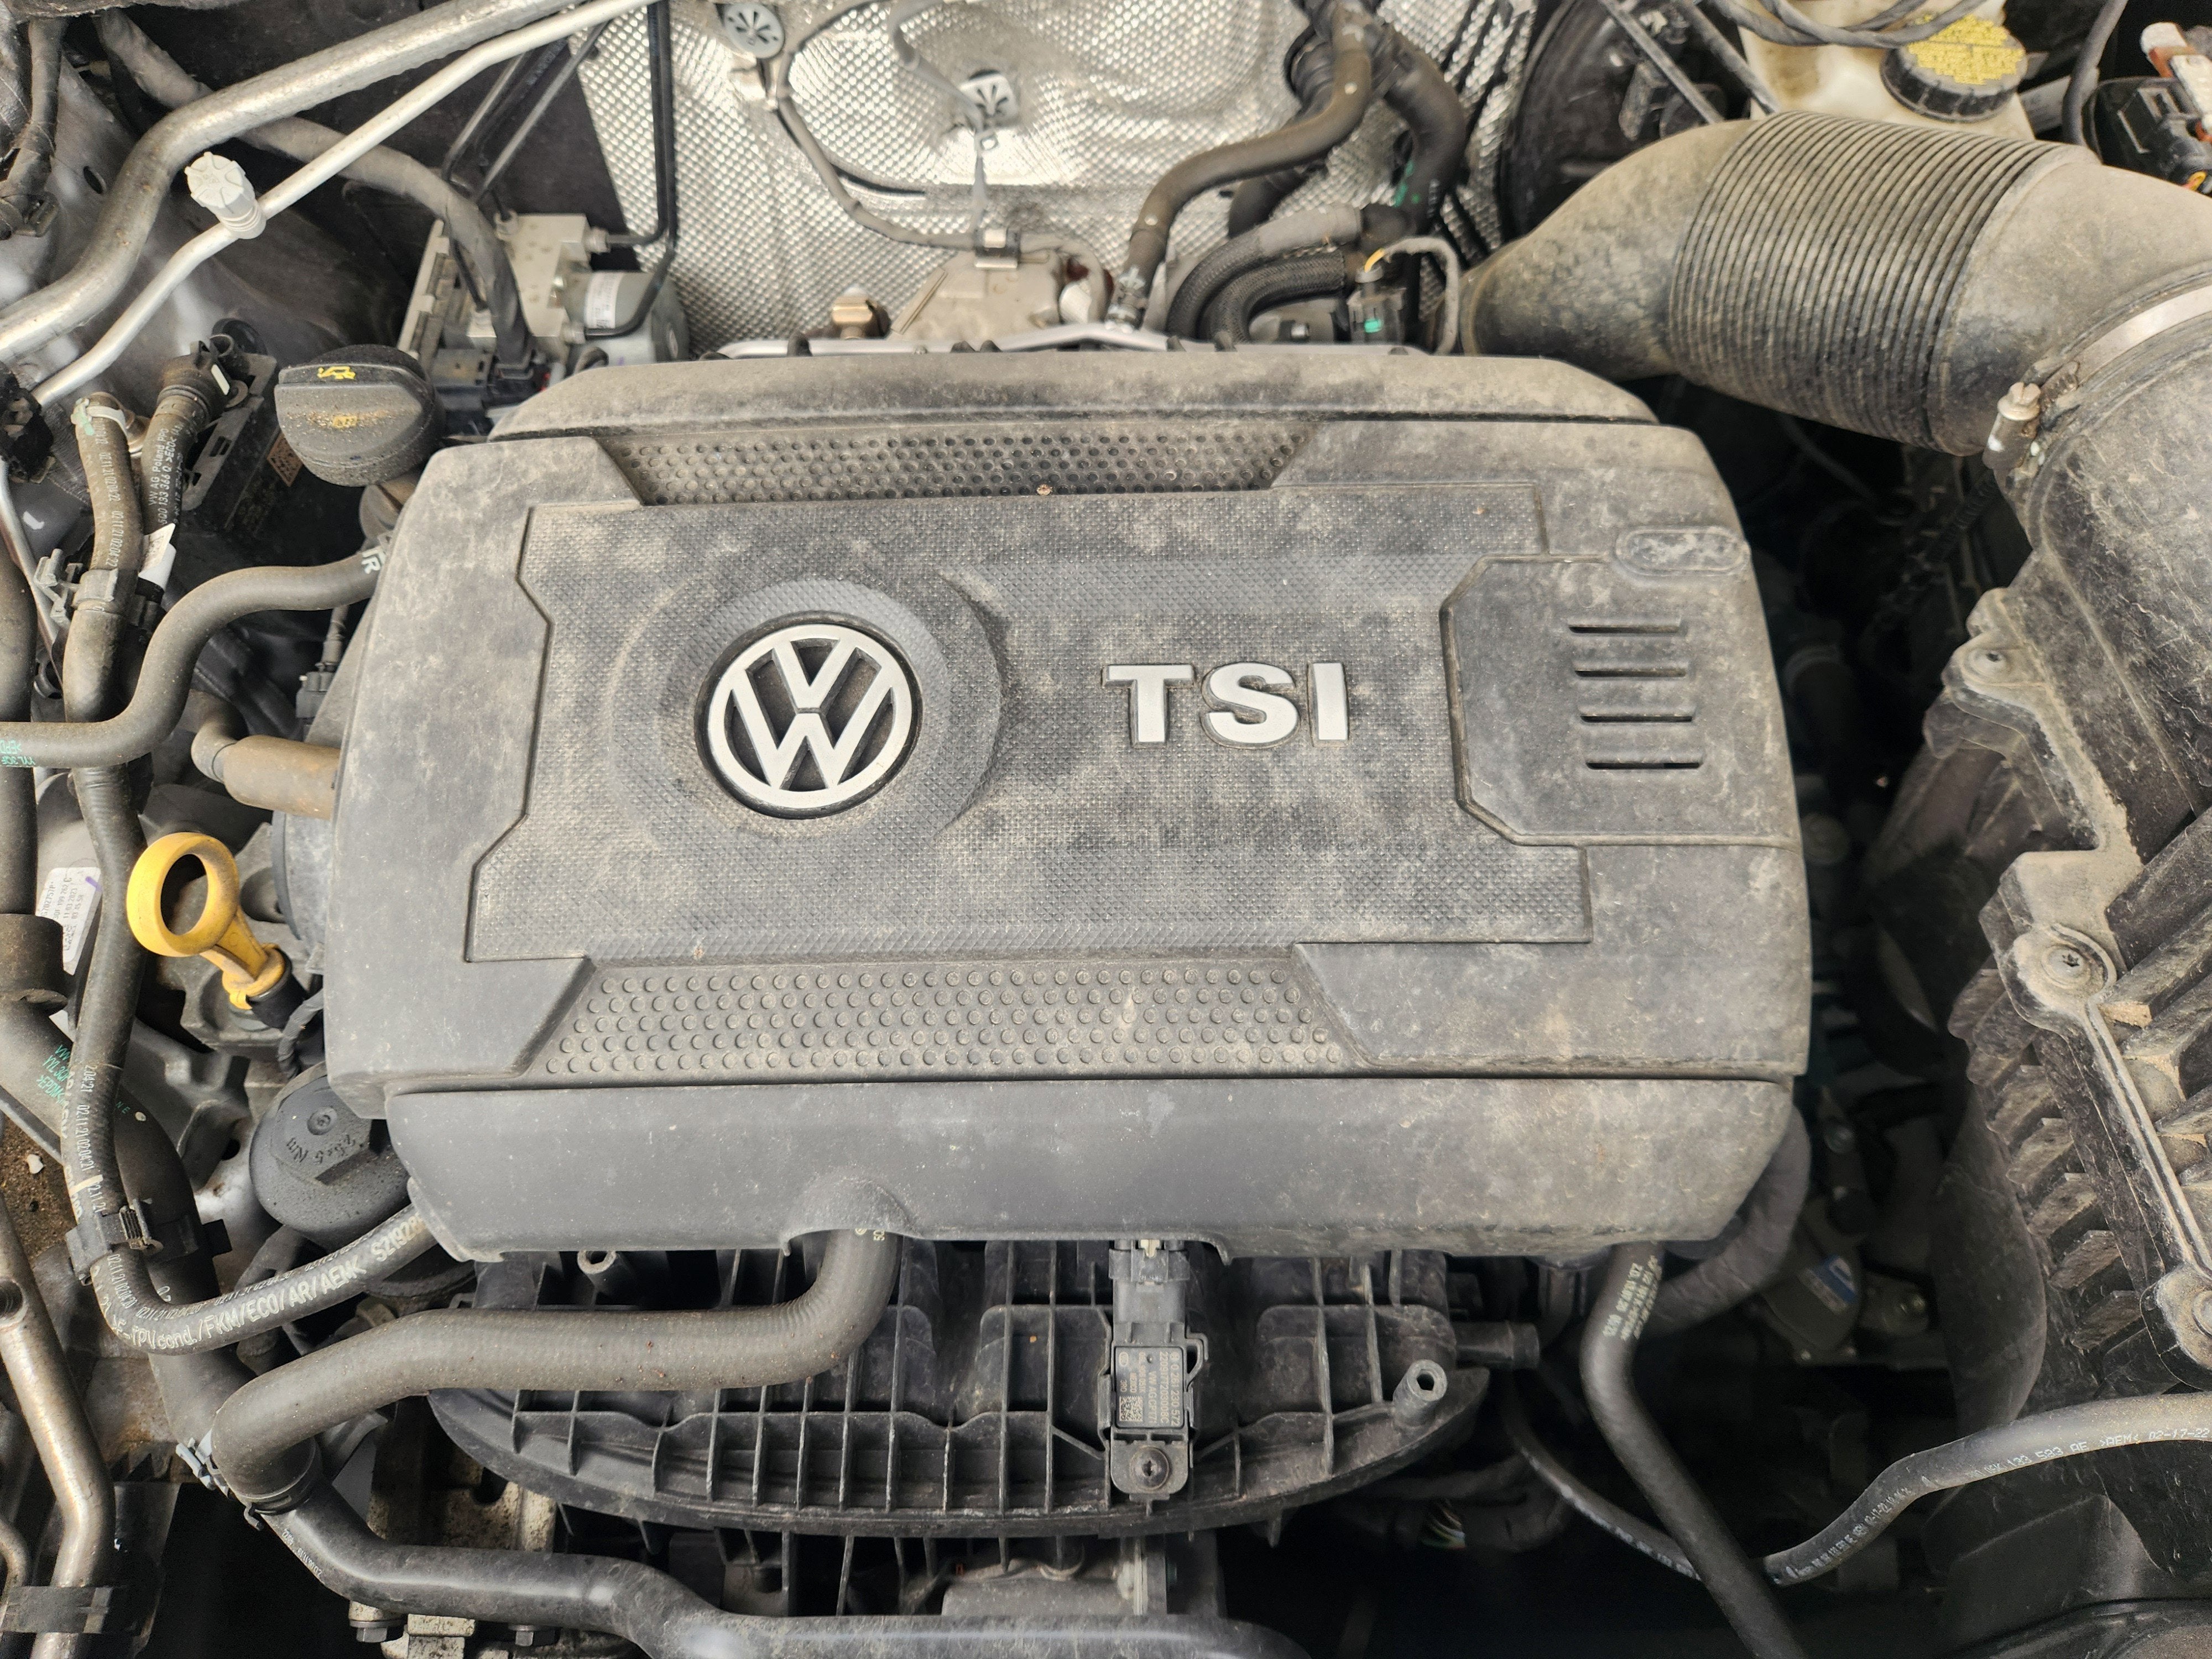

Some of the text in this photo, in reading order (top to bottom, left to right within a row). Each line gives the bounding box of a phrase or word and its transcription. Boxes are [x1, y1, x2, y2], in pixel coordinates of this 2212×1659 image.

[153, 445, 165, 472] Poland
[150, 476, 160, 489] AG
[149, 491, 158, 505] VW
[1103, 661, 1350, 748] TSI
[707, 623, 913, 809] VW
[1148, 1371, 1157, 1385] VW
[1170, 1373, 1180, 1387] 261
[1171, 1390, 1180, 1407] 230
[1171, 1410, 1180, 1426] 572
